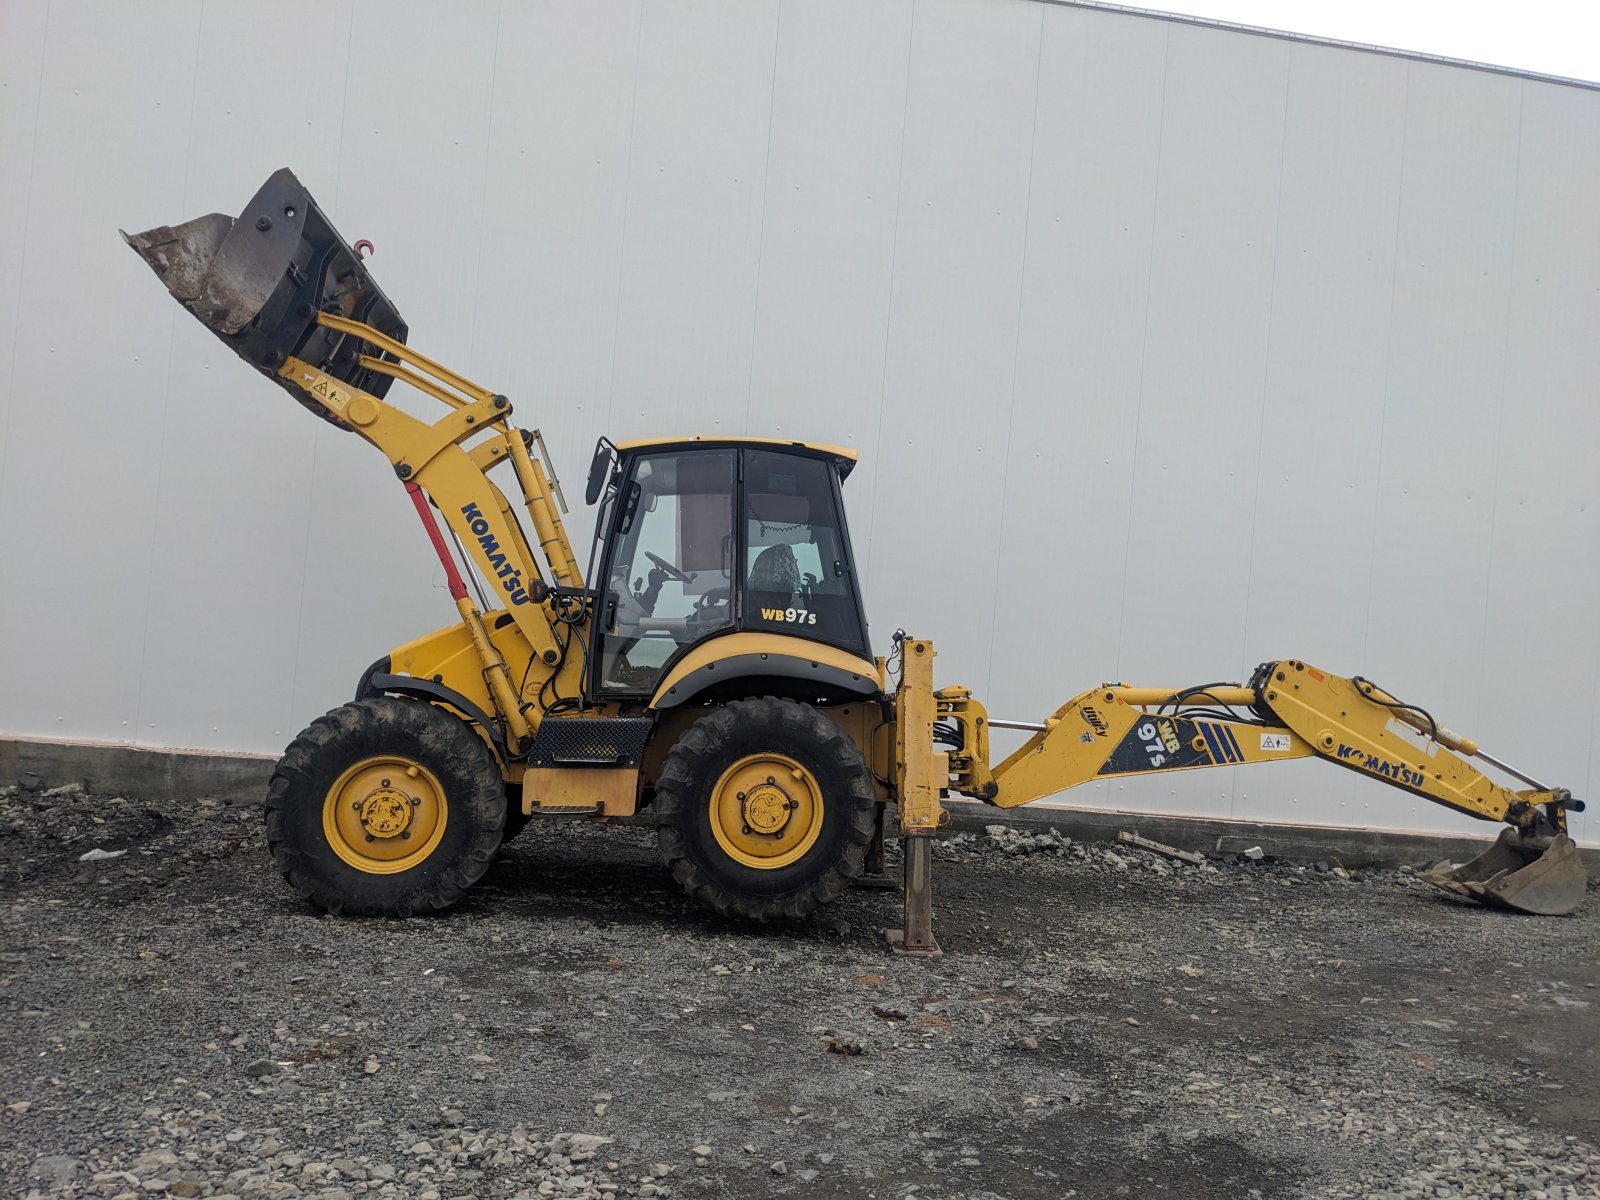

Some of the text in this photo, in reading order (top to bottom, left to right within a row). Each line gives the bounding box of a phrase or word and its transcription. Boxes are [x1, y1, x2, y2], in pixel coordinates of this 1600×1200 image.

[461, 502, 529, 606] KOMATSU
[1083, 706, 1108, 737] Utility
[1158, 720, 1180, 754] WB
